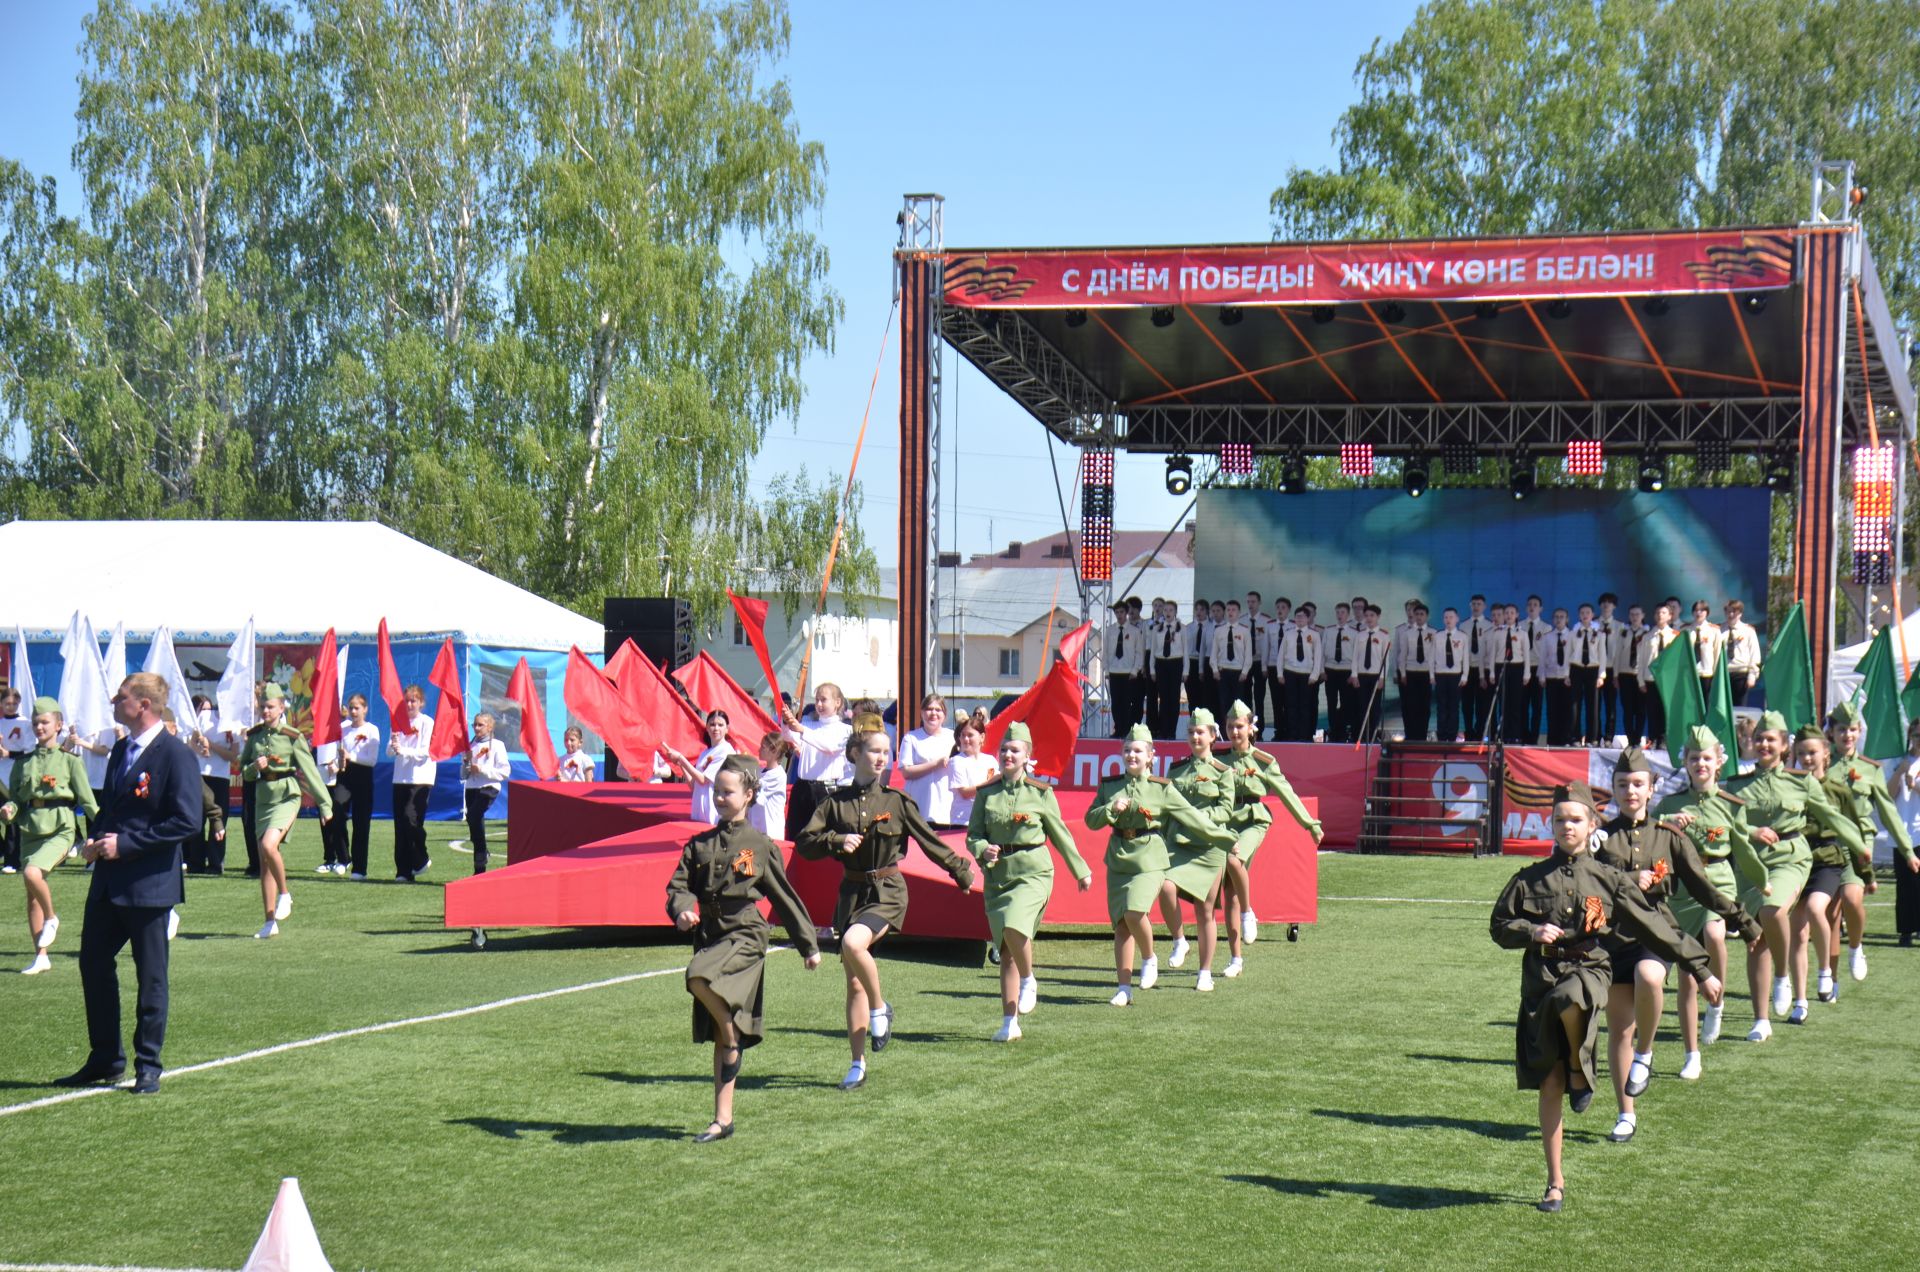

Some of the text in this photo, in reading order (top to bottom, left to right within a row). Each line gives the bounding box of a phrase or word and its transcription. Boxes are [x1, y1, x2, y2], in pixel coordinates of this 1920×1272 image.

[1061, 262, 1315, 296] С ДНЁМ ПОБЕДЫ!
[1443, 258, 1526, 284] КӨНЕ
[1536, 253, 1655, 280] БЕЛӘН!
[1432, 759, 1488, 836] 9
